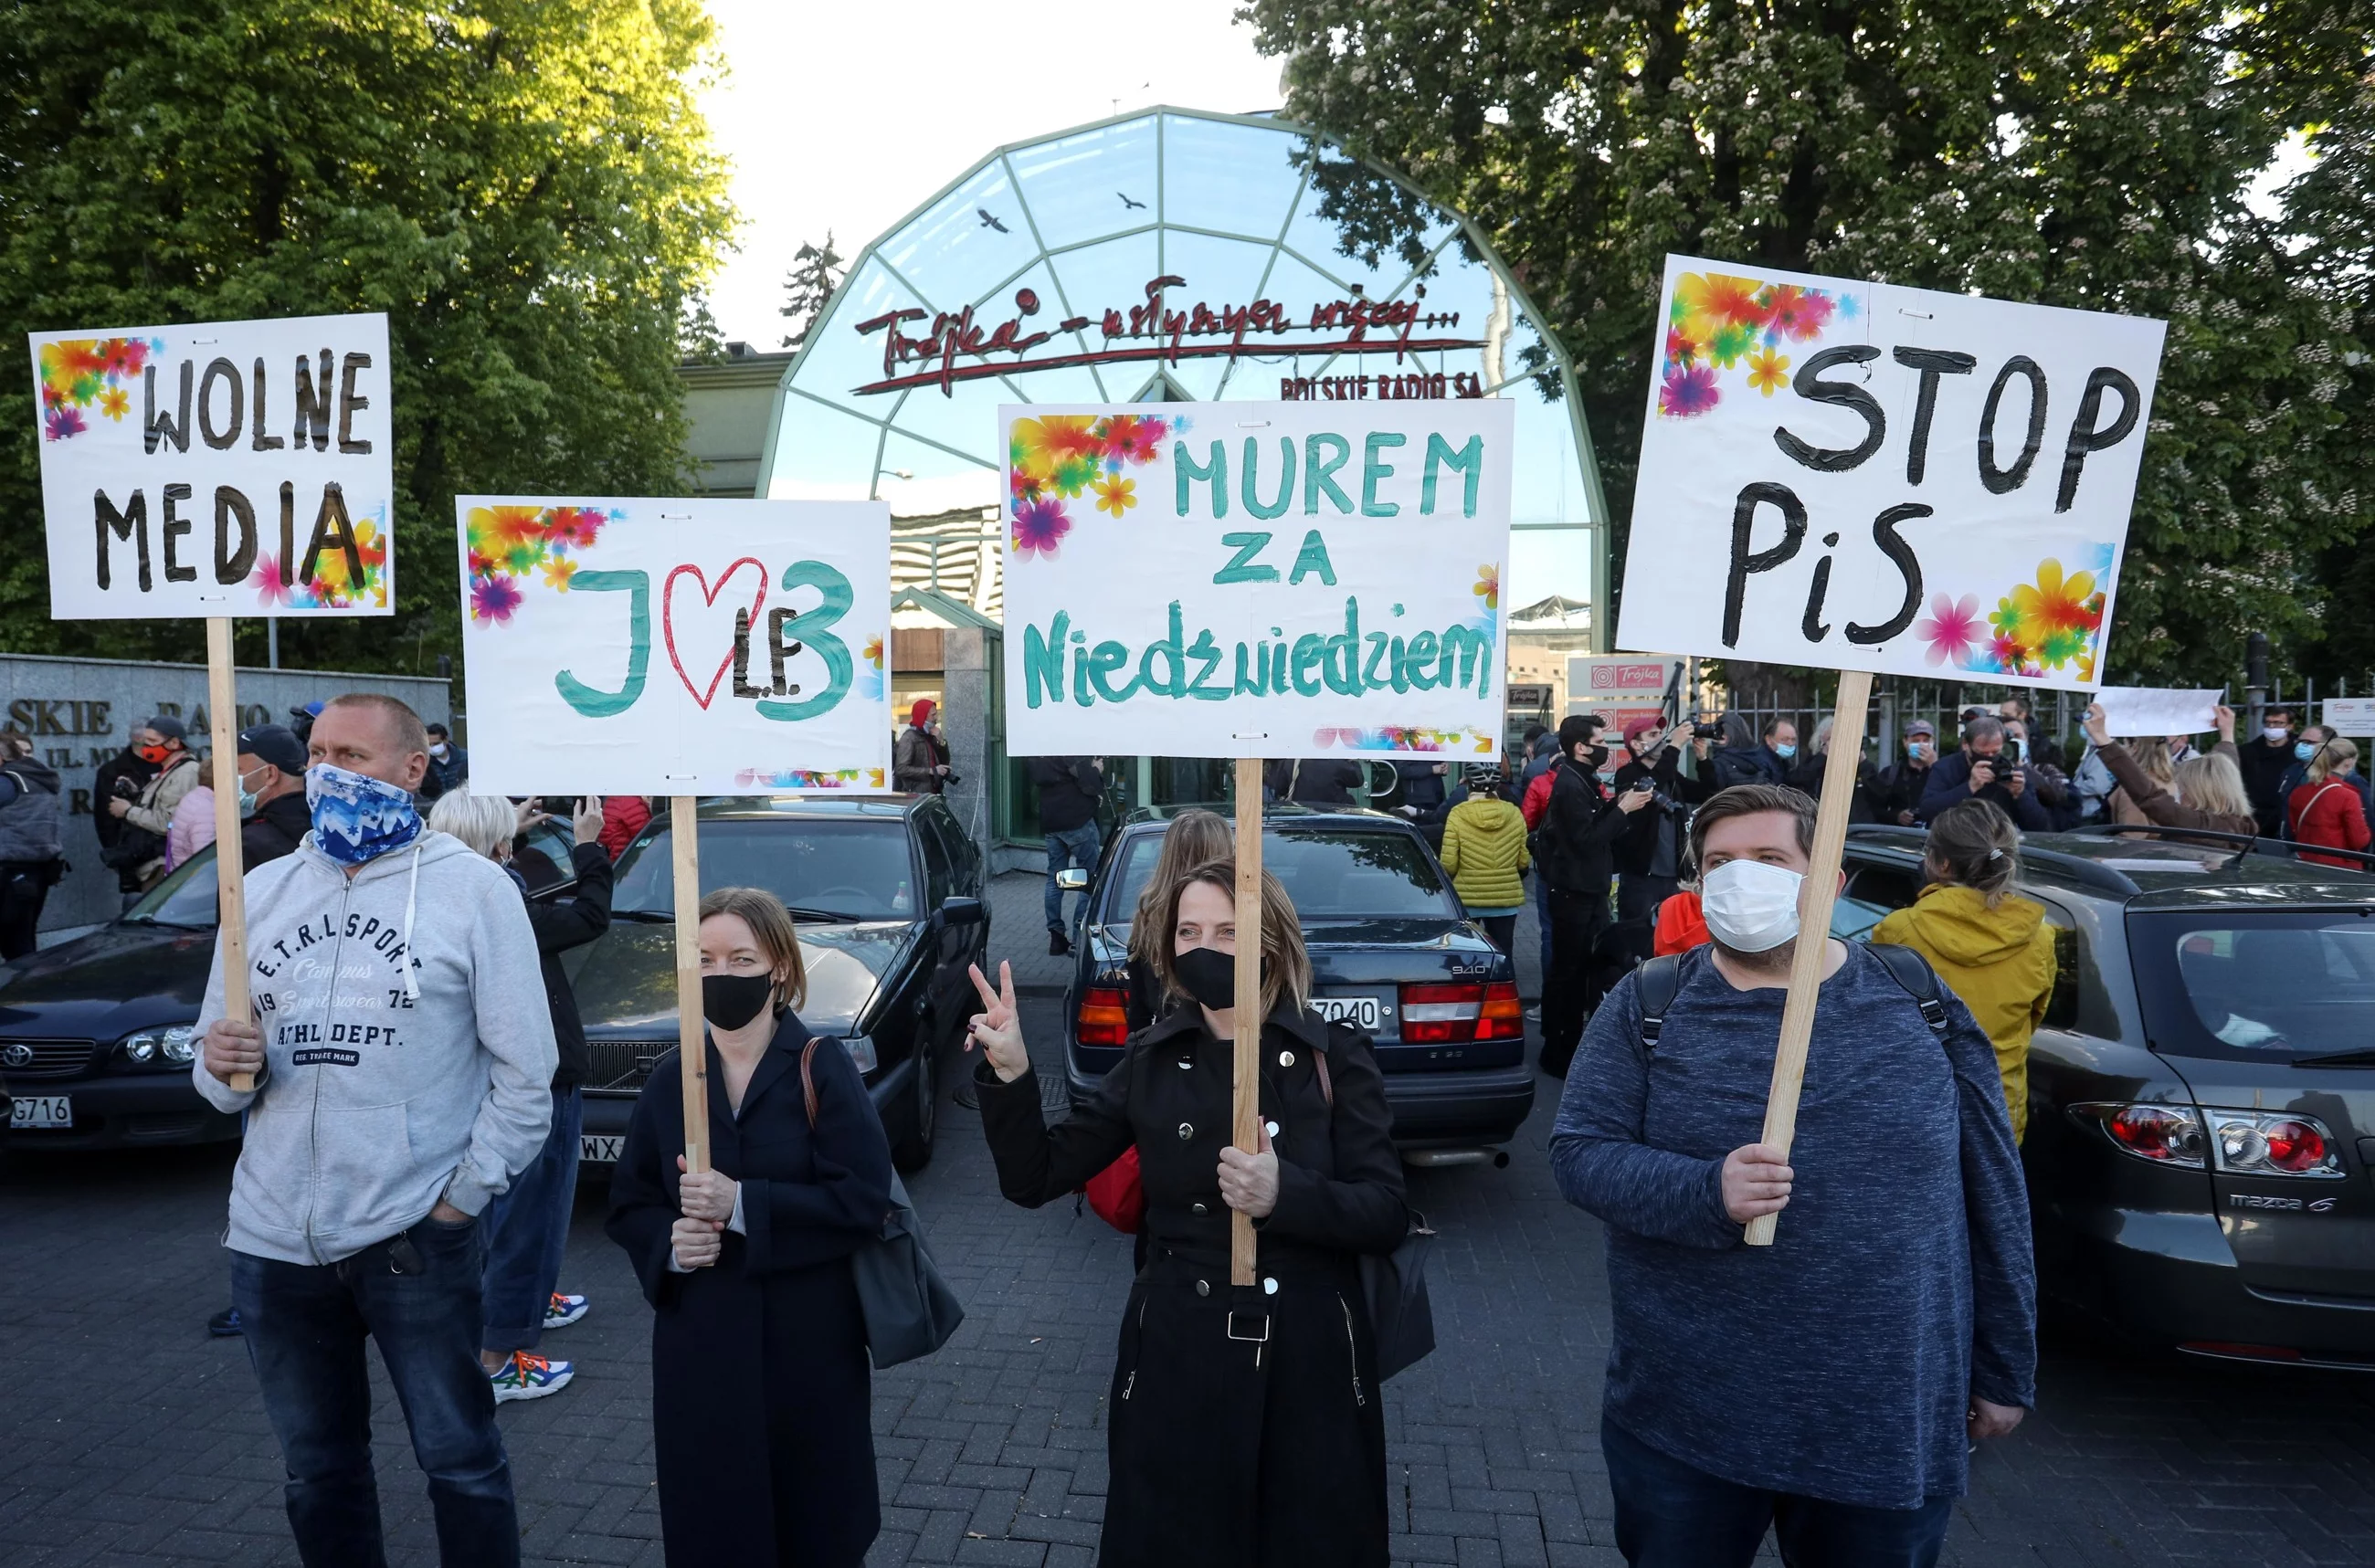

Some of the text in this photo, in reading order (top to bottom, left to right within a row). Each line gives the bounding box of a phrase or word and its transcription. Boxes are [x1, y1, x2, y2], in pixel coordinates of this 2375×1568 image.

[1281, 371, 1483, 401] POLSKIE RADIO SA
[143, 347, 374, 456] WOLNE
[1773, 344, 2141, 514] STOP
[1174, 431, 1483, 521] MUREM
[93, 480, 367, 593] MEDIA
[1213, 529, 1337, 585] ZA
[1722, 481, 1934, 649] PiS
[555, 569, 650, 718] J
[755, 560, 854, 722] 3
[1619, 666, 1660, 682] Trójka
[344, 913, 423, 974] SPORT
[292, 958, 373, 984] Campus
[1451, 965, 1485, 976] 940
[258, 993, 277, 1012] 19
[388, 990, 414, 1009] 72
[1310, 1001, 1375, 1026] 7040
[277, 1024, 404, 1046] ATHL DEPT.
[310, 1052, 332, 1060] TRADE
[332, 1053, 356, 1062] MARK
[581, 1137, 618, 1160] WX
[2308, 1197, 2338, 1212] 6
